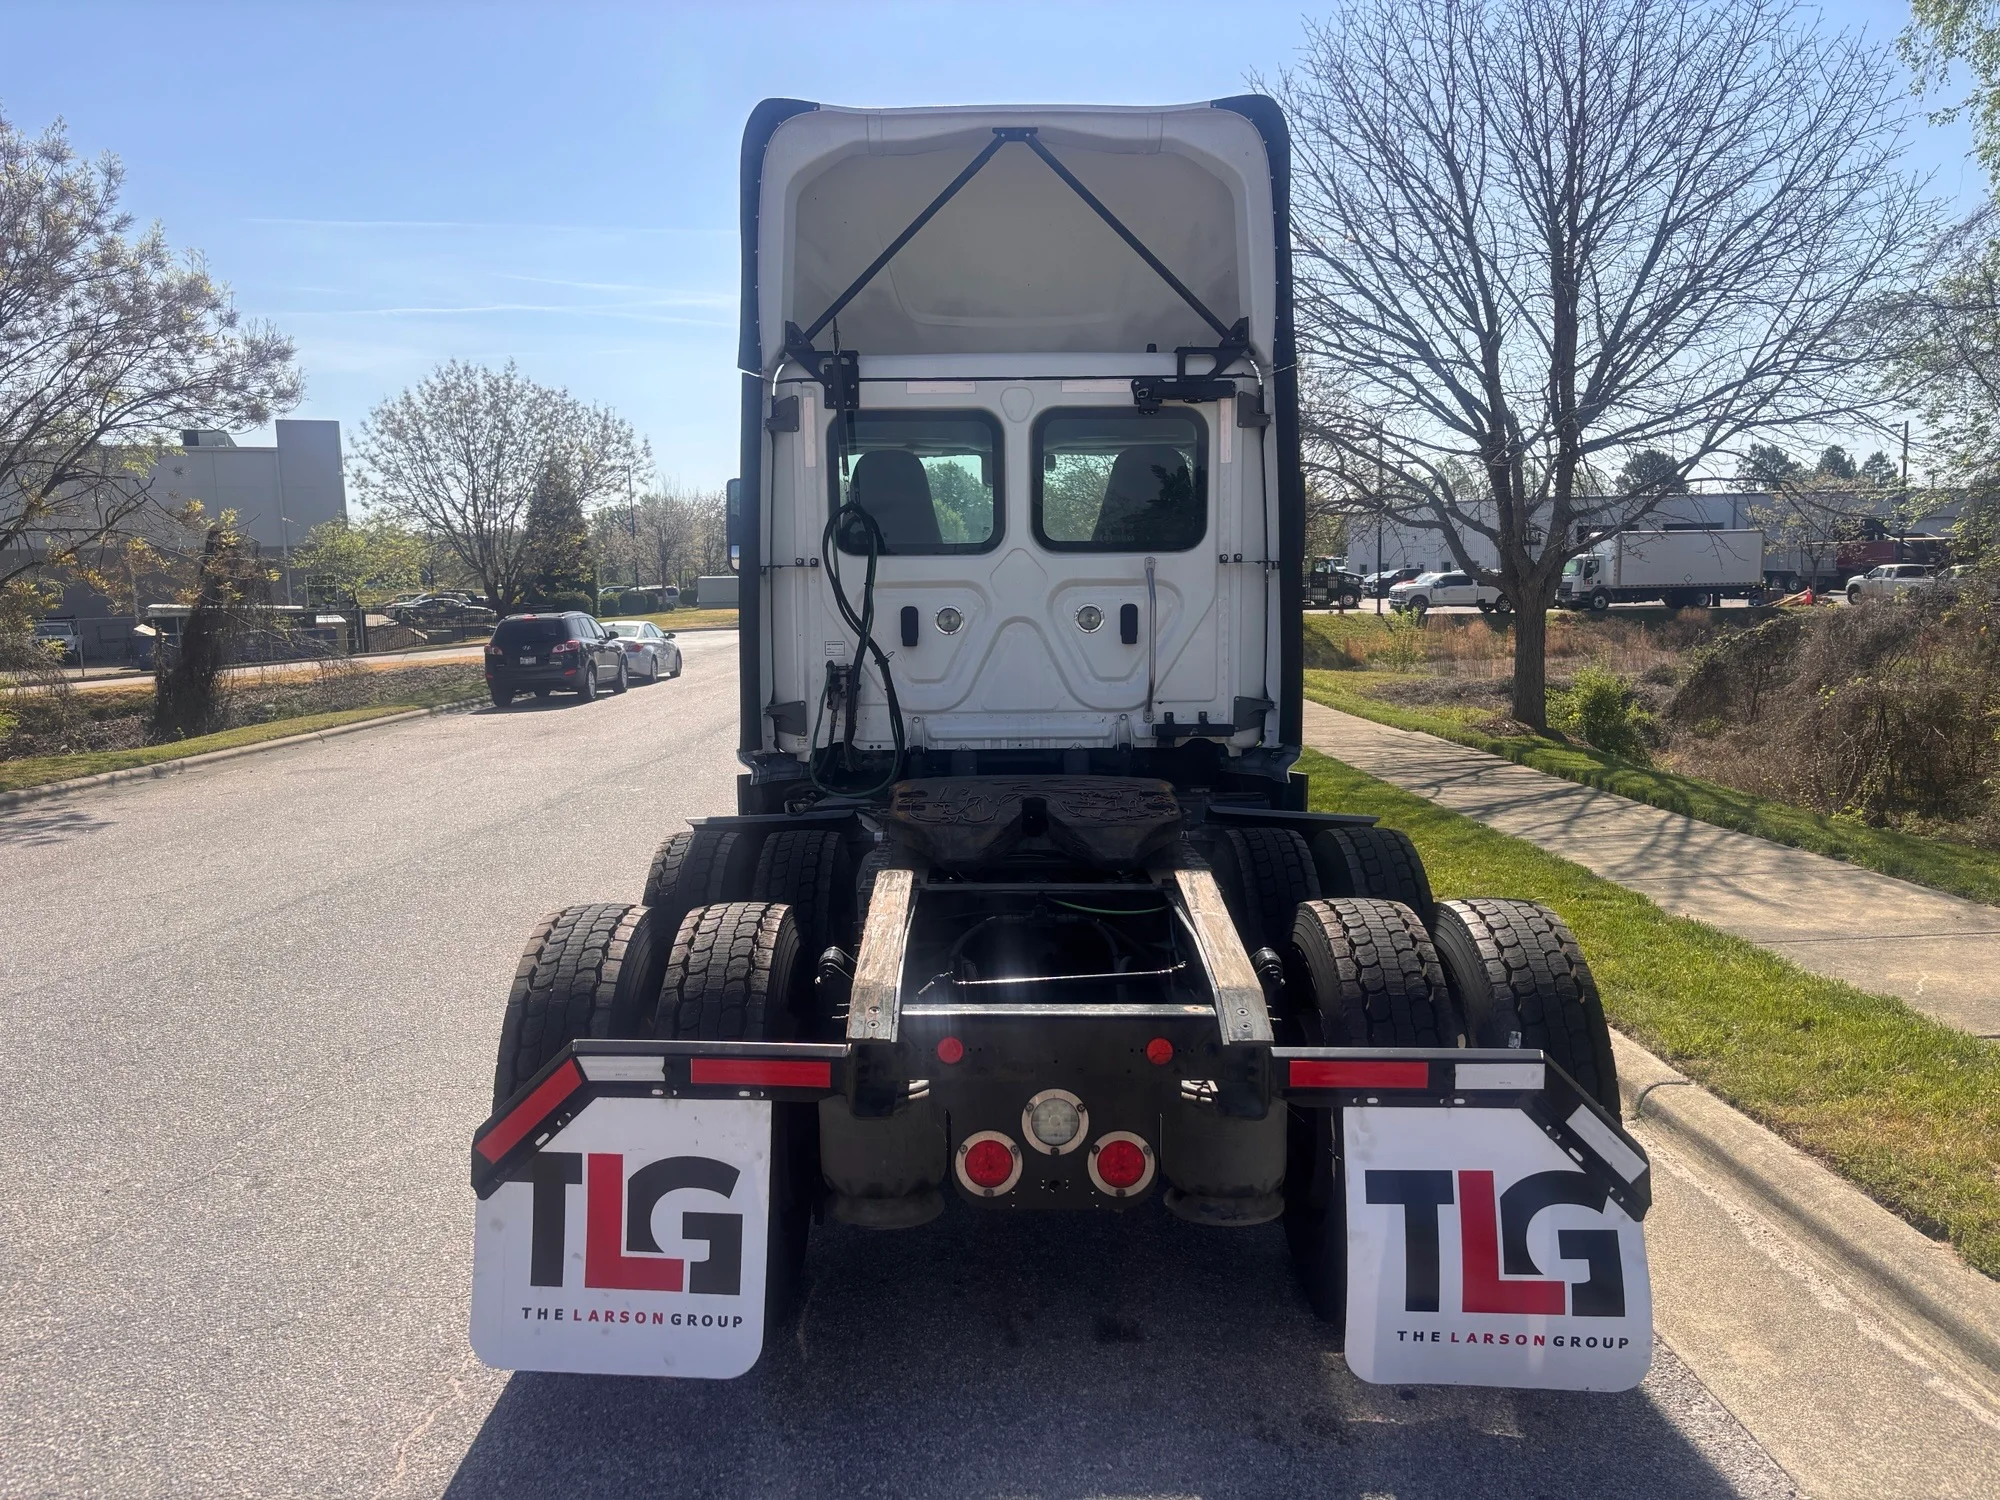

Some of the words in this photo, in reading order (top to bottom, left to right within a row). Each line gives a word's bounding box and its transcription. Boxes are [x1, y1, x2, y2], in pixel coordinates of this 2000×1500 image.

[505, 1151, 743, 1296] TLG
[1364, 1169, 1626, 1317] TLG
[521, 1307, 564, 1321] THE
[573, 1309, 664, 1325] LARSON
[670, 1313, 743, 1328] GROUP
[1397, 1330, 1441, 1342] THE
[1450, 1332, 1546, 1346] LARSON
[1552, 1335, 1629, 1349] GROUP
